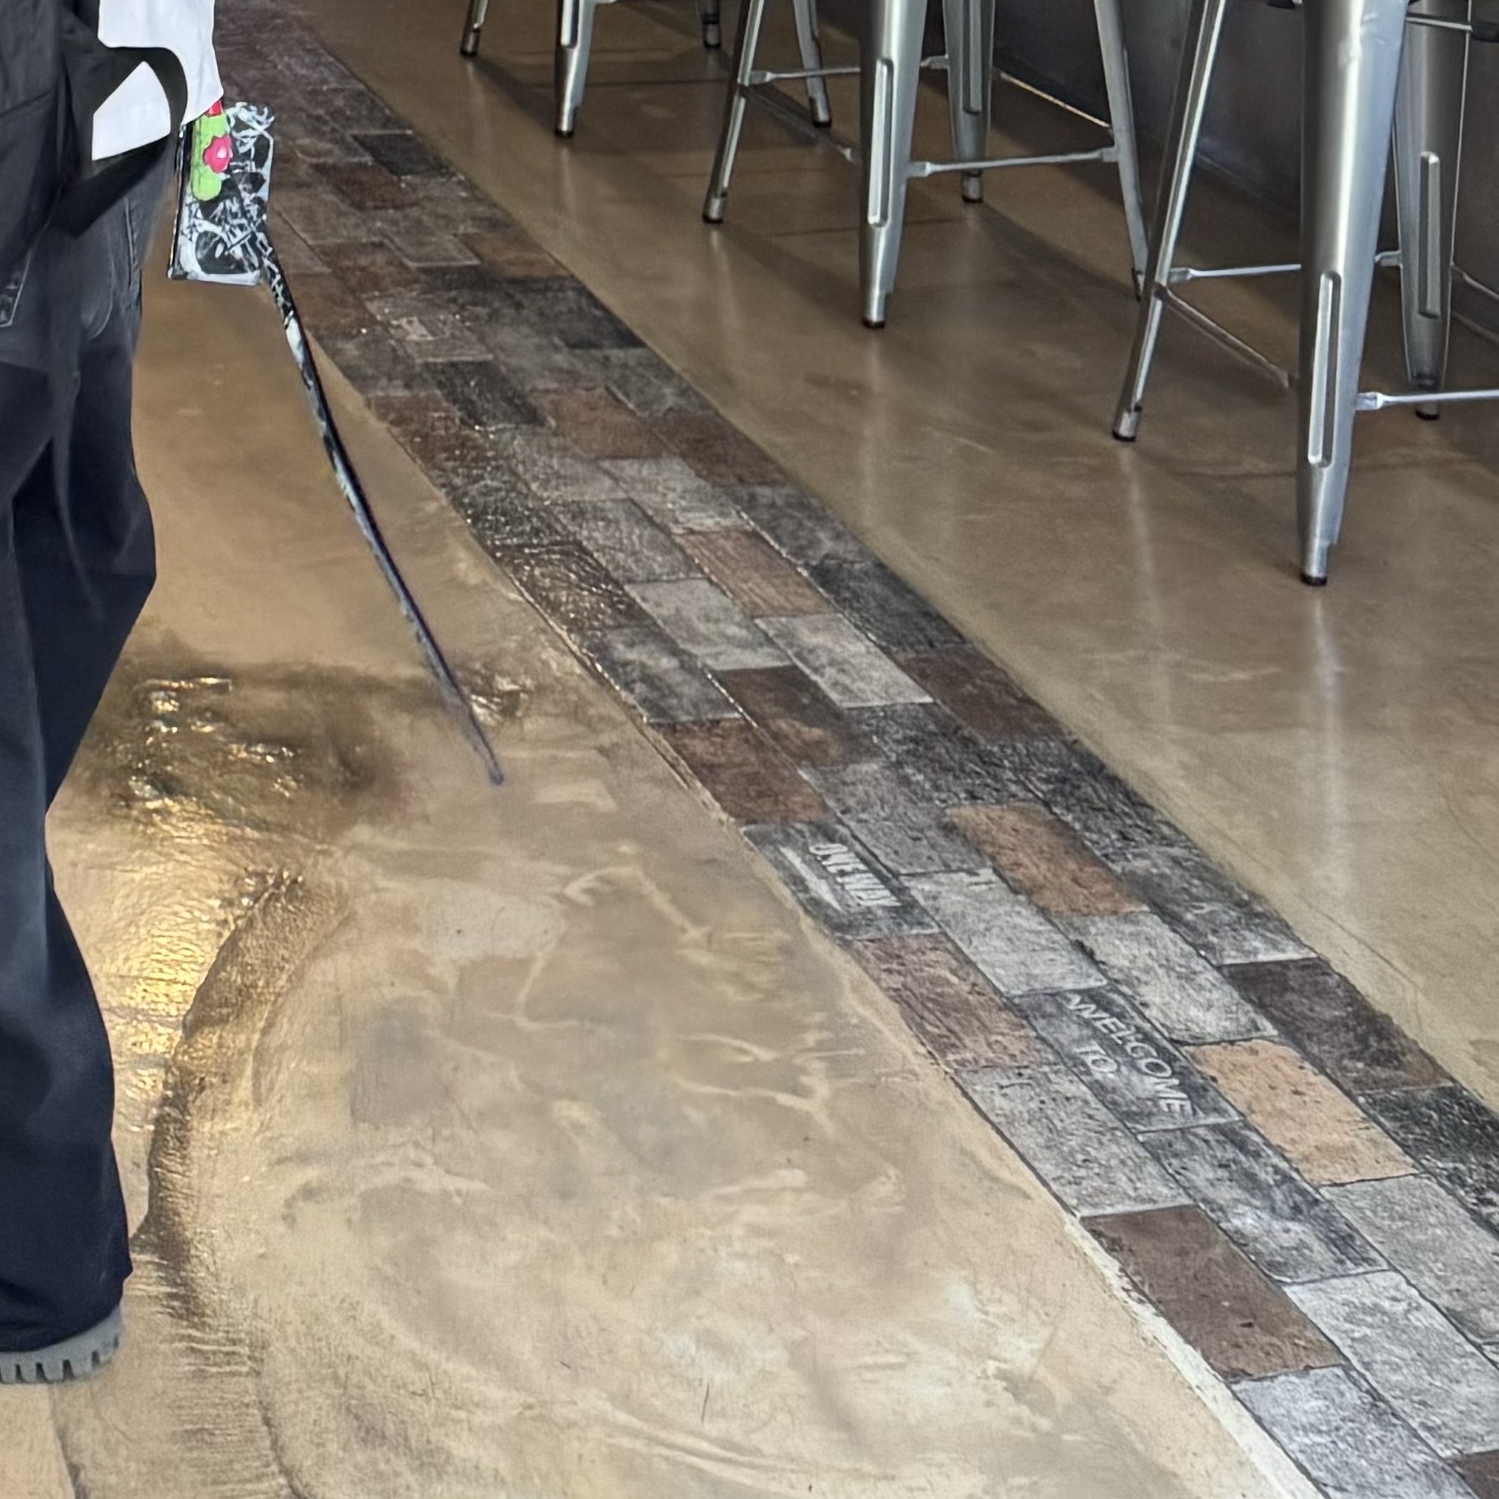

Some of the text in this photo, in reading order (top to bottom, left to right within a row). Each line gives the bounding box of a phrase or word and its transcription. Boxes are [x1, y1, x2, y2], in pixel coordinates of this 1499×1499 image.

[809, 843, 902, 907] ONE WAY
[1064, 992, 1194, 1115] WELCOME
[1074, 1040, 1119, 1073] TO
